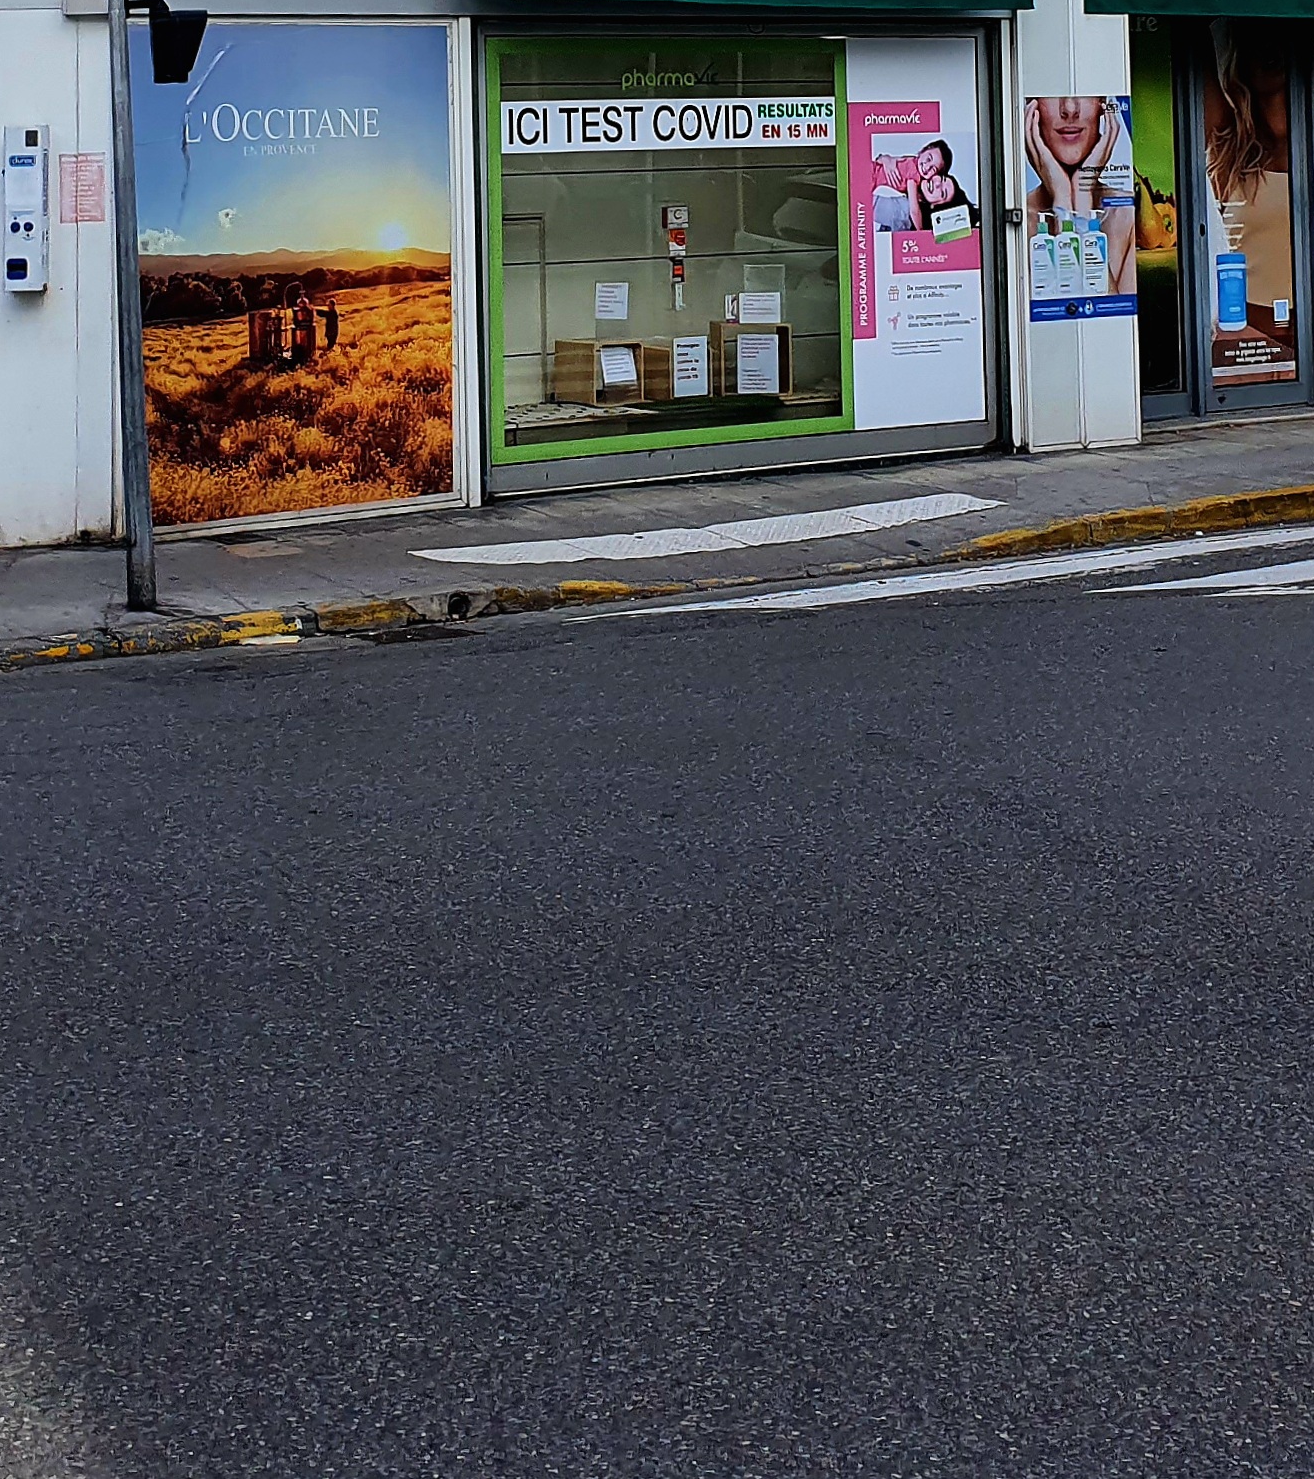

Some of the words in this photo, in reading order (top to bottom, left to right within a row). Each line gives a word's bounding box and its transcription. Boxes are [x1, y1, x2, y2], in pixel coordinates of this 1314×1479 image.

[508, 107, 549, 145] ICI
[558, 105, 643, 144] TEST
[653, 104, 753, 142] COVID
[757, 102, 833, 119] RESULTATS
[762, 125, 781, 139] EN
[787, 124, 802, 138] 15
[807, 123, 828, 138] MN
[857, 203, 867, 249] AFFINITY
[860, 252, 868, 326] PROGRAMME
